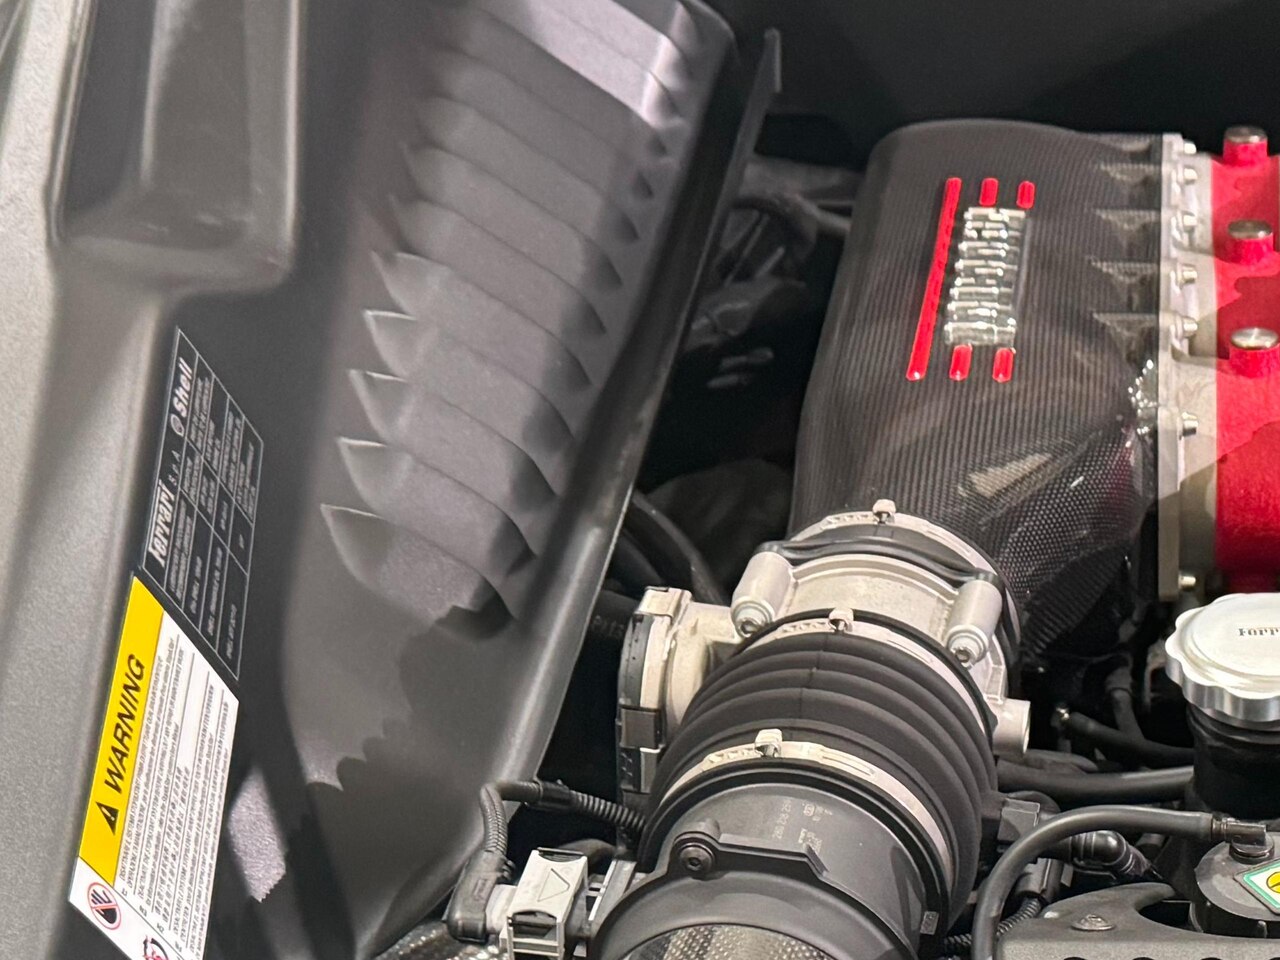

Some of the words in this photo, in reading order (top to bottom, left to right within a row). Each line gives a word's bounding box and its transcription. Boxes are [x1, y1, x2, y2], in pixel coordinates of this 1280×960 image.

[173, 356, 193, 418] Shell
[148, 478, 175, 568] Ferrari
[104, 653, 145, 794] WARNING
